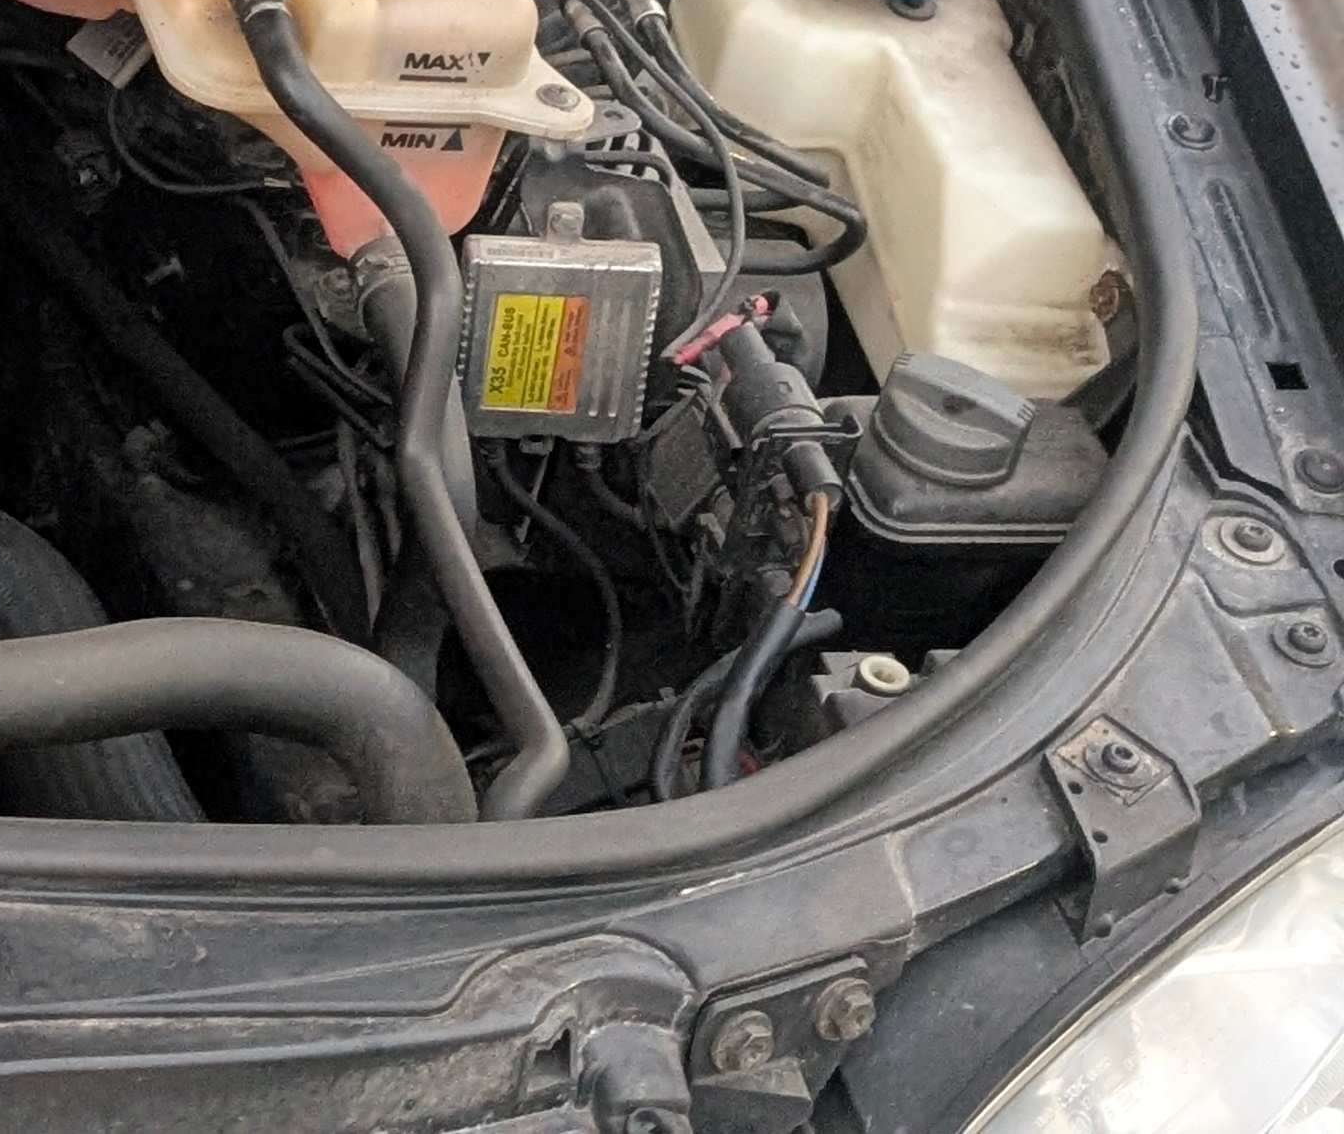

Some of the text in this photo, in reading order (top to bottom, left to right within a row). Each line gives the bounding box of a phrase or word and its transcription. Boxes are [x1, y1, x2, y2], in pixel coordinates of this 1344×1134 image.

[404, 52, 464, 70] MAX
[380, 131, 436, 149] MIN
[489, 366, 505, 395] X35
